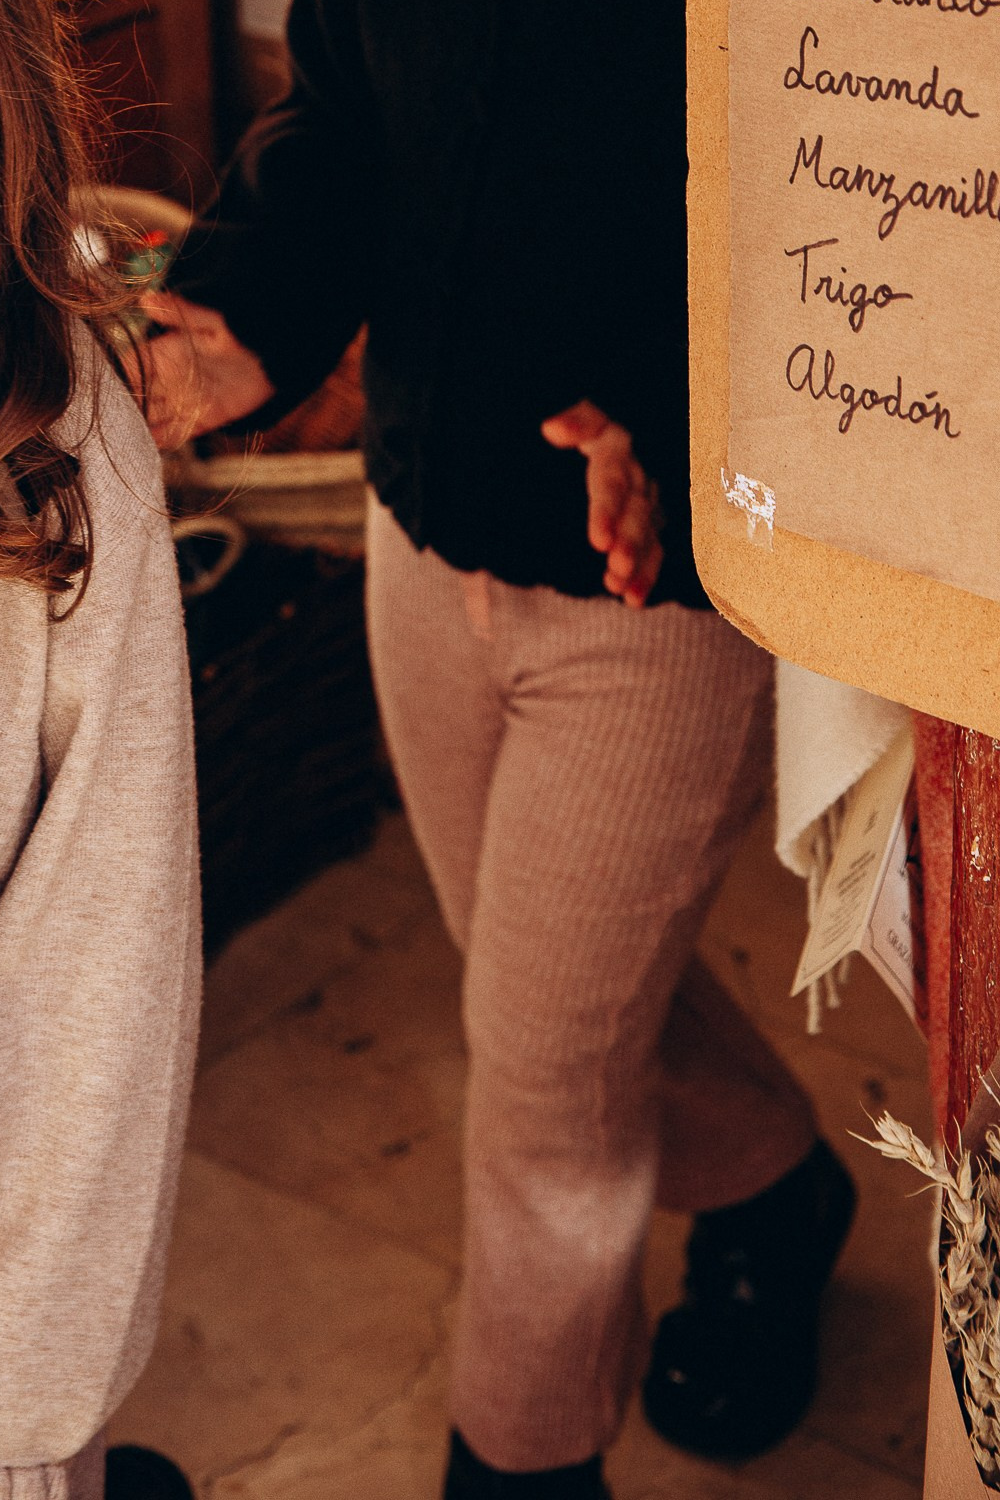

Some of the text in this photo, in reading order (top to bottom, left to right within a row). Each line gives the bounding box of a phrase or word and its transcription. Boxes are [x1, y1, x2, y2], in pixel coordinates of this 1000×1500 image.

[784, 26, 980, 118] Lavanda
[789, 134, 1000, 240] Manzanill
[784, 238, 914, 334] Trigo
[785, 343, 961, 438] Algodón
